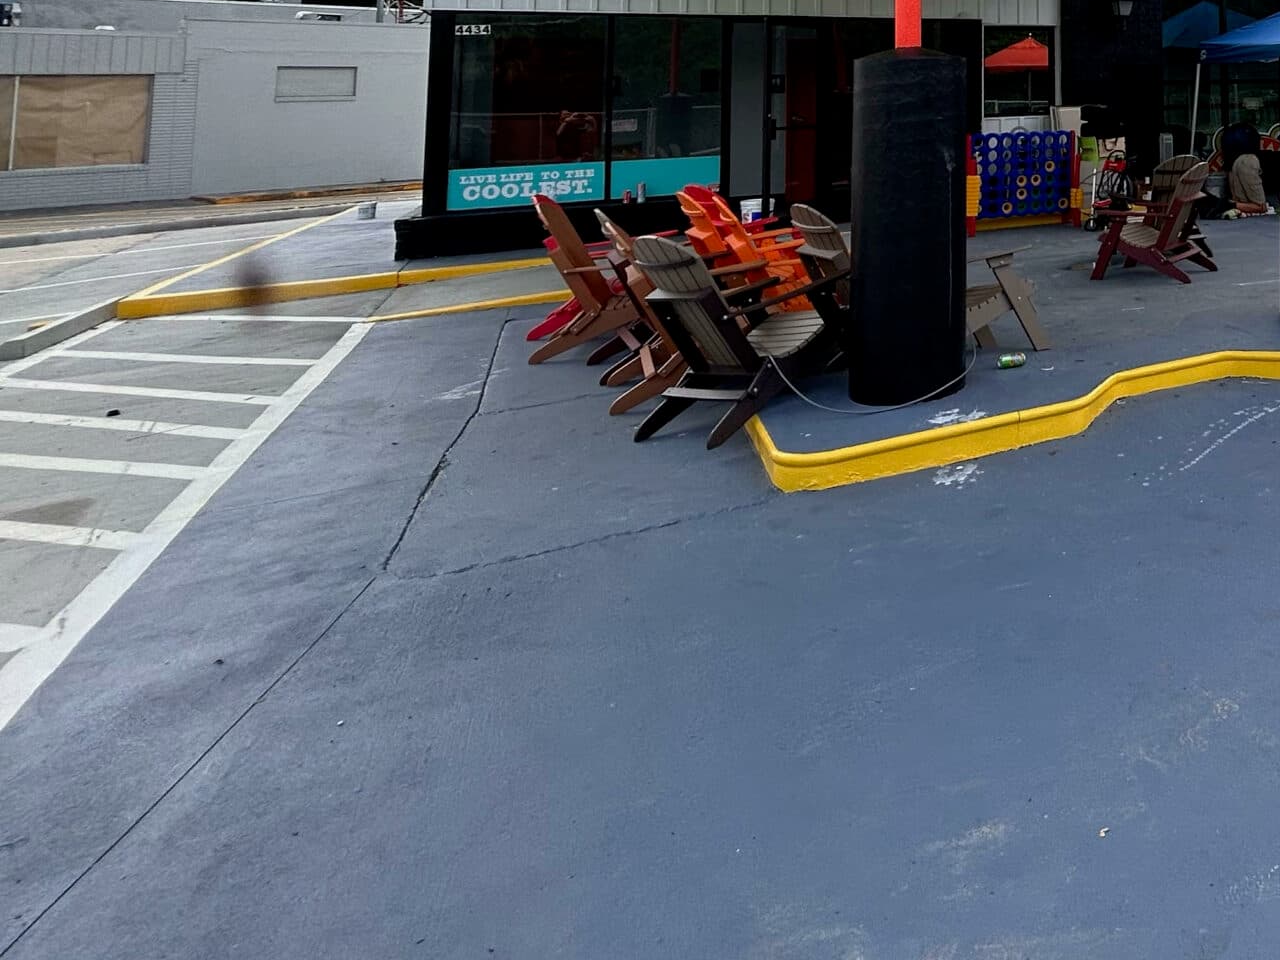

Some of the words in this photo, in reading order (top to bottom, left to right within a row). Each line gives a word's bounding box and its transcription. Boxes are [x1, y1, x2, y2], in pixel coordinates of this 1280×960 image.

[455, 25, 491, 35] 4434
[459, 174, 496, 185] LIVE
[500, 172, 534, 183] LIFE
[541, 170, 560, 180] TO
[565, 168, 595, 179] THE
[462, 179, 593, 202] COOLEST.
